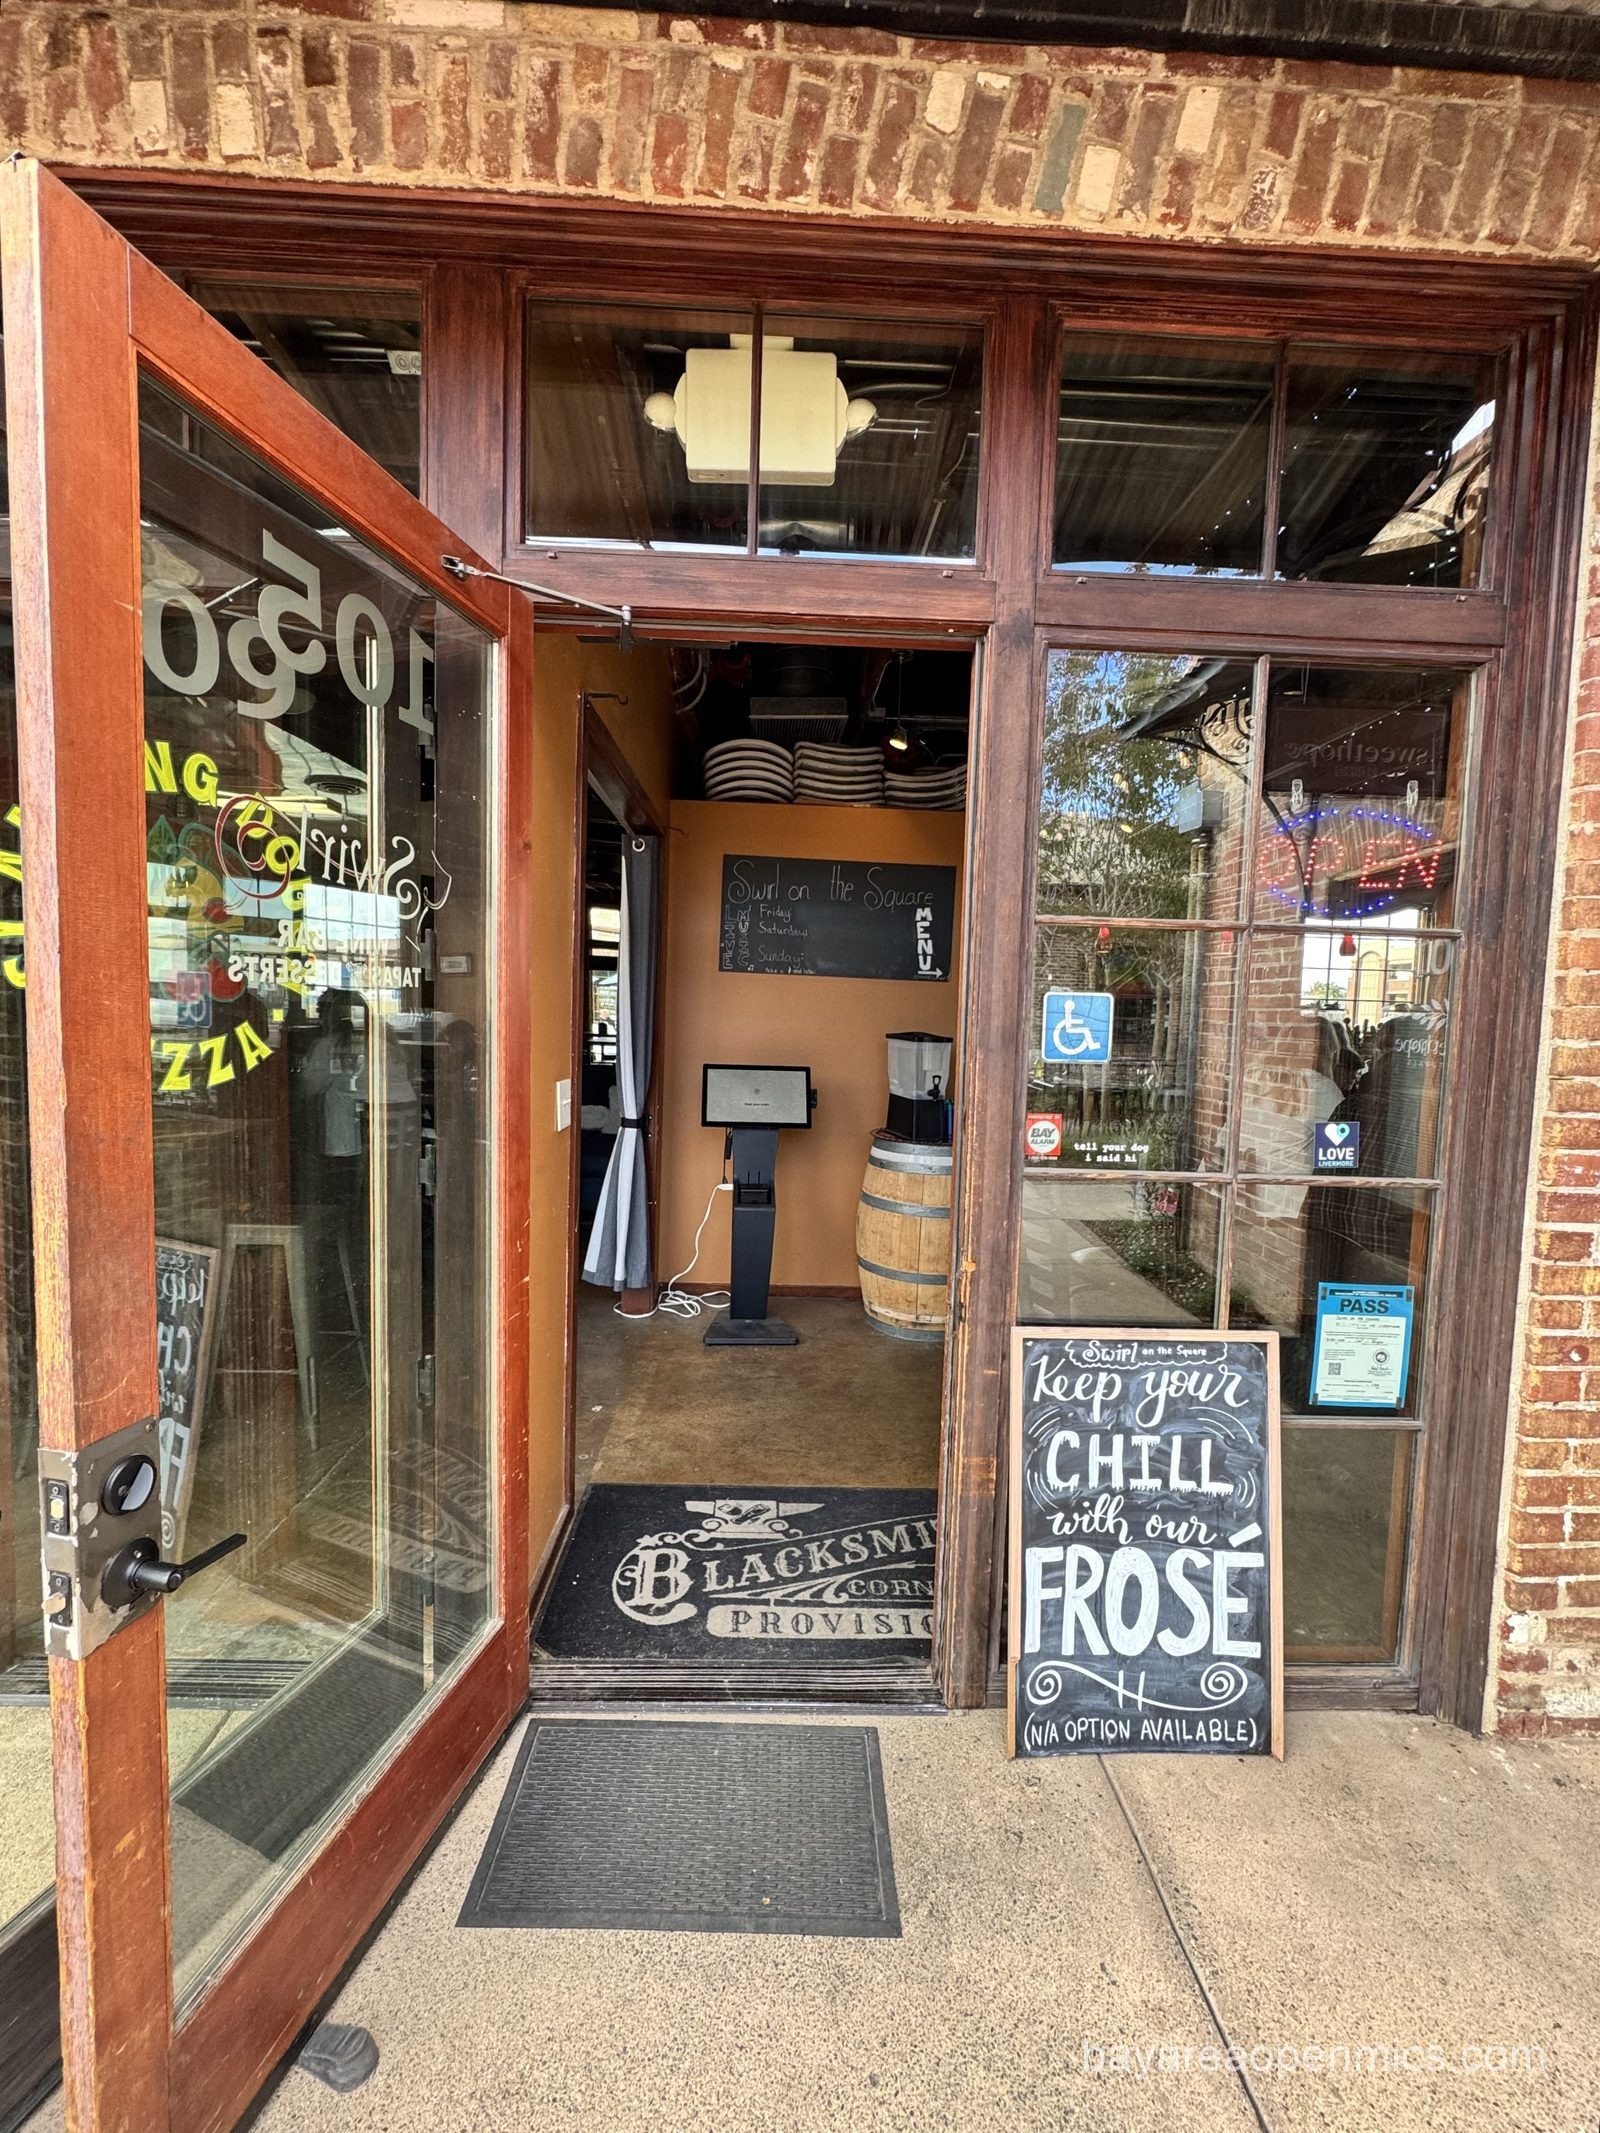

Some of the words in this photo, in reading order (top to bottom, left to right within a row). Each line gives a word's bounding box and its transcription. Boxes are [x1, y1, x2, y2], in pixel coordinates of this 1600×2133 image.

[1256, 836, 1444, 889] OPEN
[727, 859, 780, 904] Swirl
[788, 884, 810, 901] on
[830, 865, 854, 902] the
[863, 866, 934, 912] Square
[758, 945, 805, 969] Sunday:
[915, 907, 933, 971] MENU
[1031, 1128, 1055, 1138] BAY
[1074, 1142, 1097, 1151] tell
[1103, 1144, 1126, 1153] your
[1131, 1143, 1149, 1153] dog
[1096, 1153, 1120, 1162] said
[1124, 1154, 1137, 1162] hi
[1318, 1147, 1355, 1161] LOVE
[1340, 1298, 1390, 1314] PASS
[1082, 1340, 1137, 1363] Swirl
[1142, 1347, 1154, 1356] on
[1157, 1345, 1172, 1355] the
[1176, 1345, 1207, 1356] Square
[1030, 1355, 1122, 1423] Keep
[1135, 1364, 1249, 1428] your
[1046, 1430, 1234, 1497] CHILL
[1046, 1493, 1133, 1545] with
[1145, 1513, 1217, 1544] our
[625, 1517, 937, 1607] BLACKSMI
[847, 1578, 934, 1596] CORN
[1024, 1522, 1264, 1658] FROSÉ
[1024, 1712, 1059, 1751] (N/A
[1064, 1717, 1130, 1742] OPTION
[1140, 1717, 1257, 1747] AVAILABLE)
